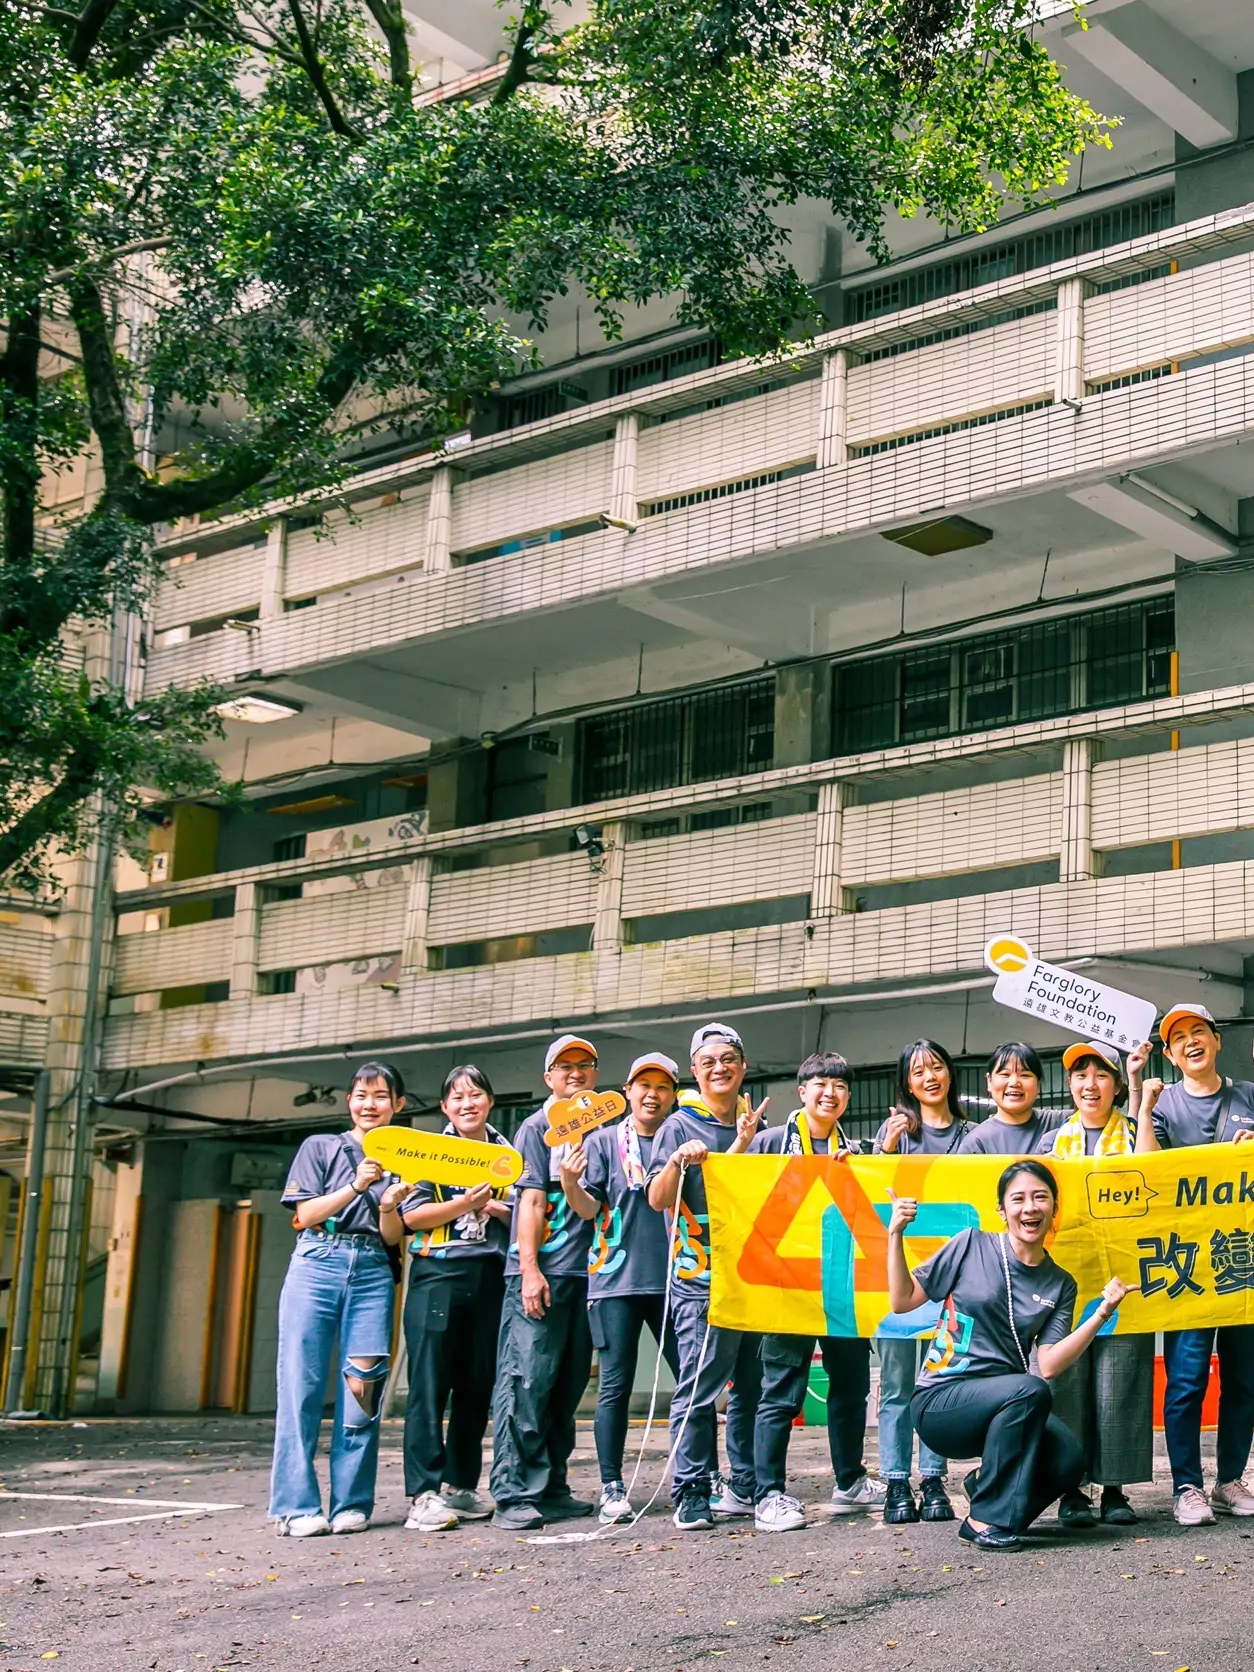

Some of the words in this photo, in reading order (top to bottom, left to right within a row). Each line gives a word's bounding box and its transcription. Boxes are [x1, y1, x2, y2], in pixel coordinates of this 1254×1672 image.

[1033, 965, 1102, 1003] Farglory
[1027, 980, 1118, 1026] Foundation
[396, 1147, 427, 1160] Make
[429, 1152, 438, 1161] it
[440, 1153, 492, 1168] Possible!
[1099, 1187, 1140, 1205] Hey!
